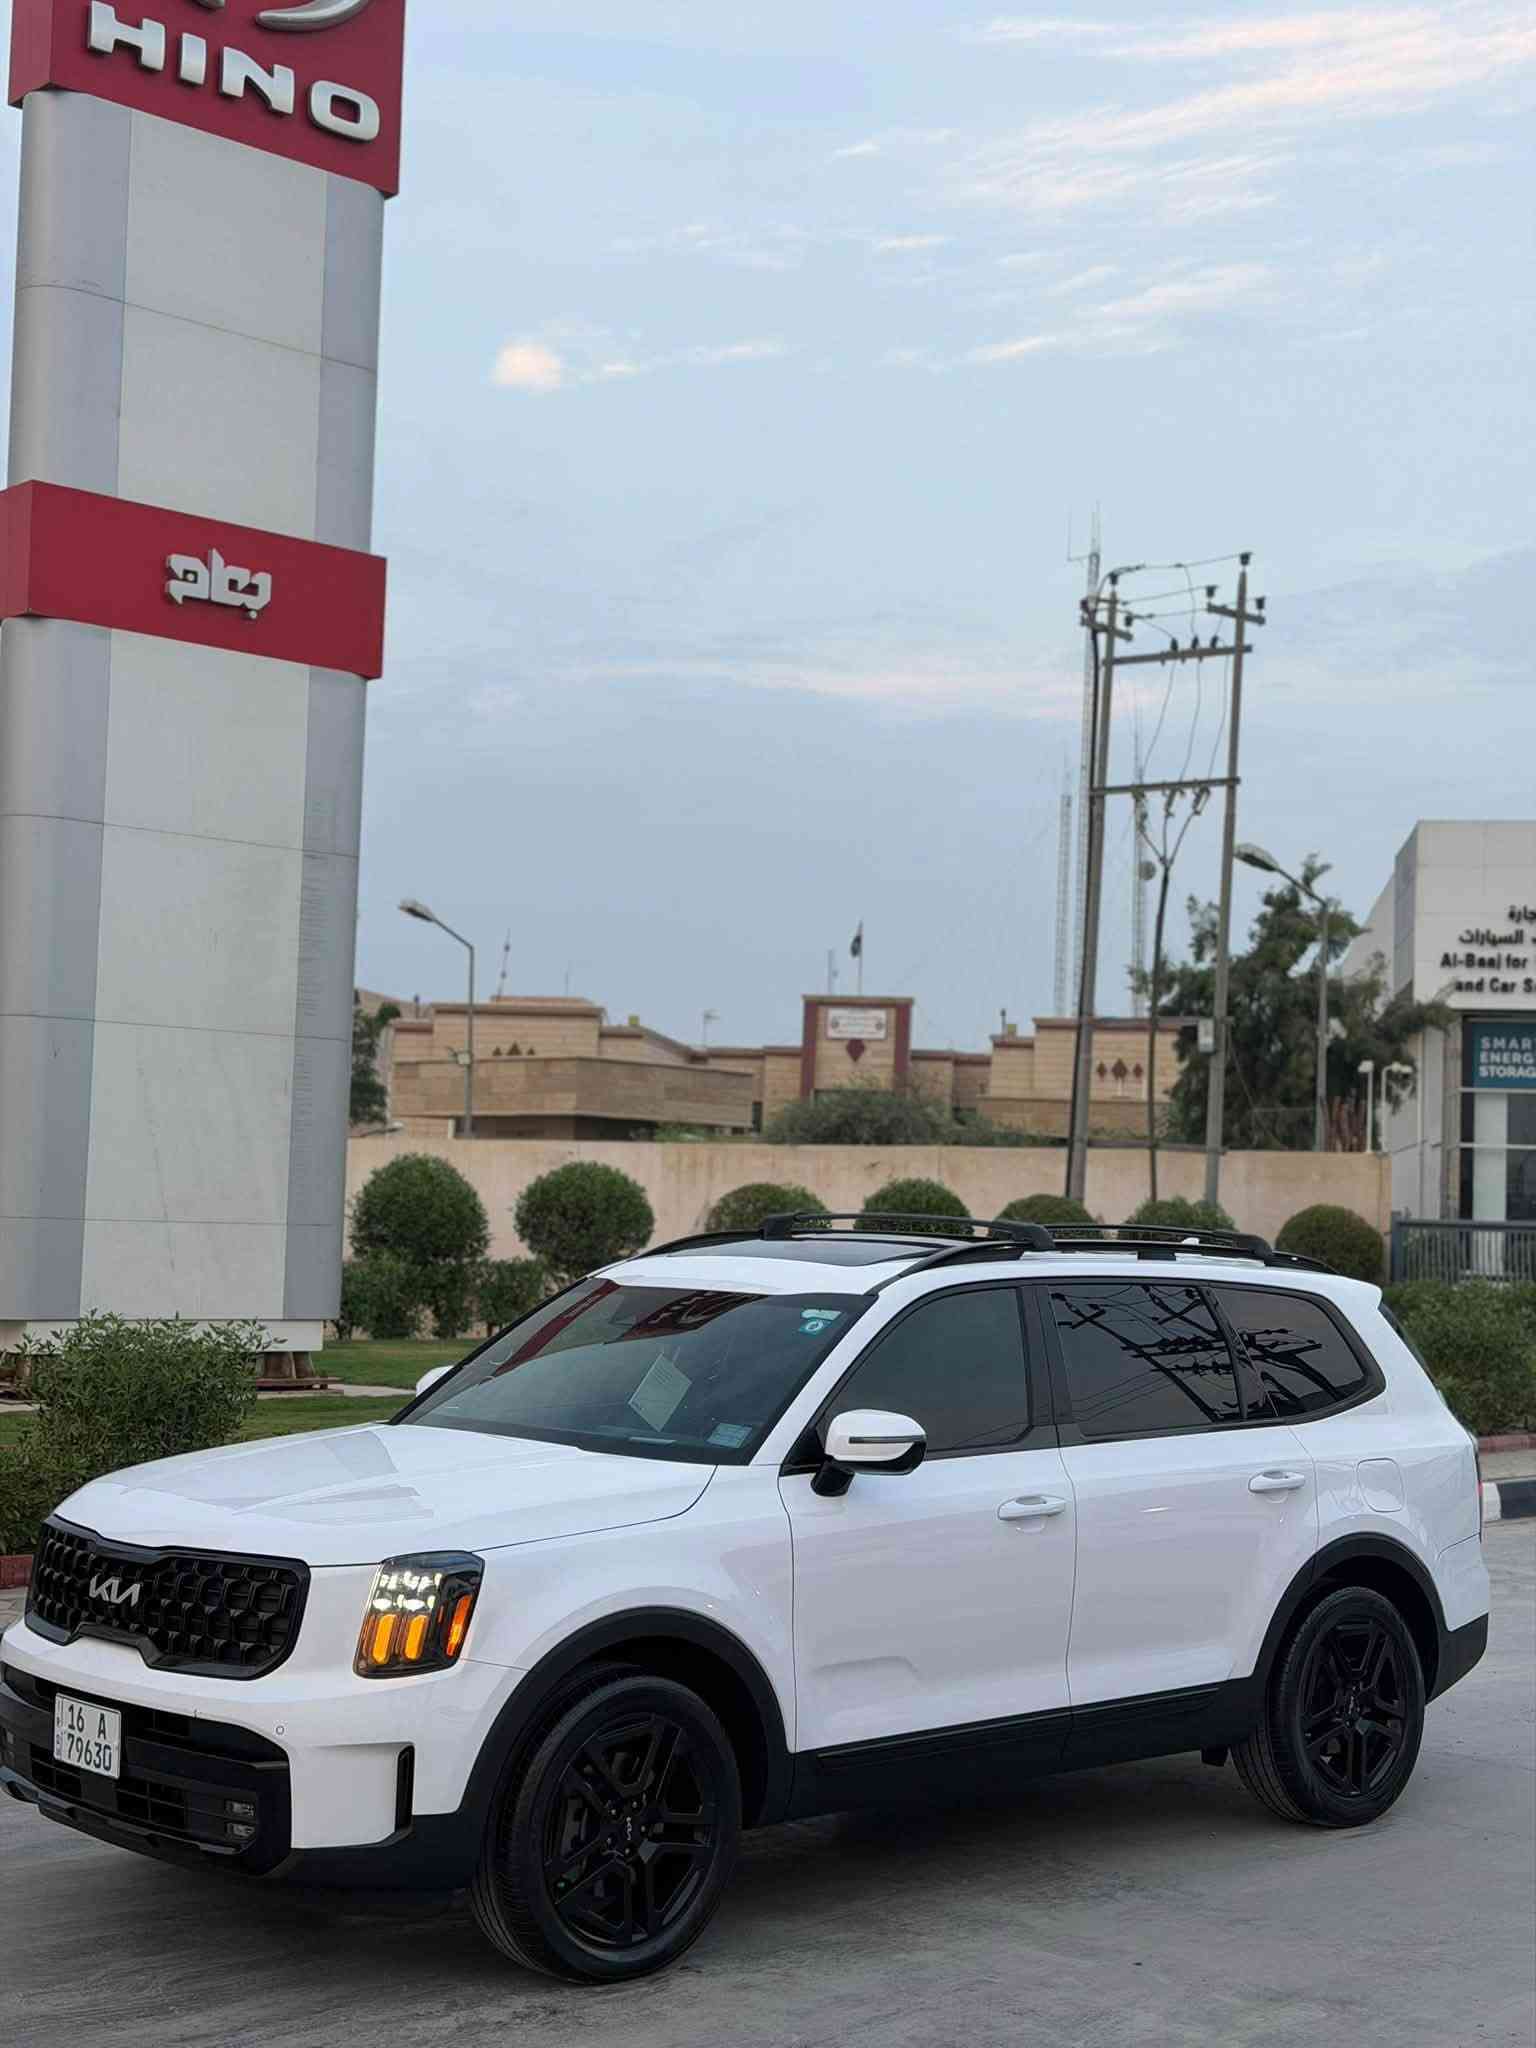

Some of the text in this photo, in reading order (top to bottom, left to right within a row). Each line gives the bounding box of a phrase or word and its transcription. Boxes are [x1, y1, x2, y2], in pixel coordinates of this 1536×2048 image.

[88, 0, 381, 142] HINO
[1458, 929, 1524, 947] السيارات
[1441, 952, 1528, 970] Al-Baaj for
[1455, 977, 1484, 993] and
[1489, 977, 1516, 993] Car
[68, 1704, 85, 1733] 16
[97, 1713, 107, 1740] A
[67, 1732, 112, 1772] 79630
